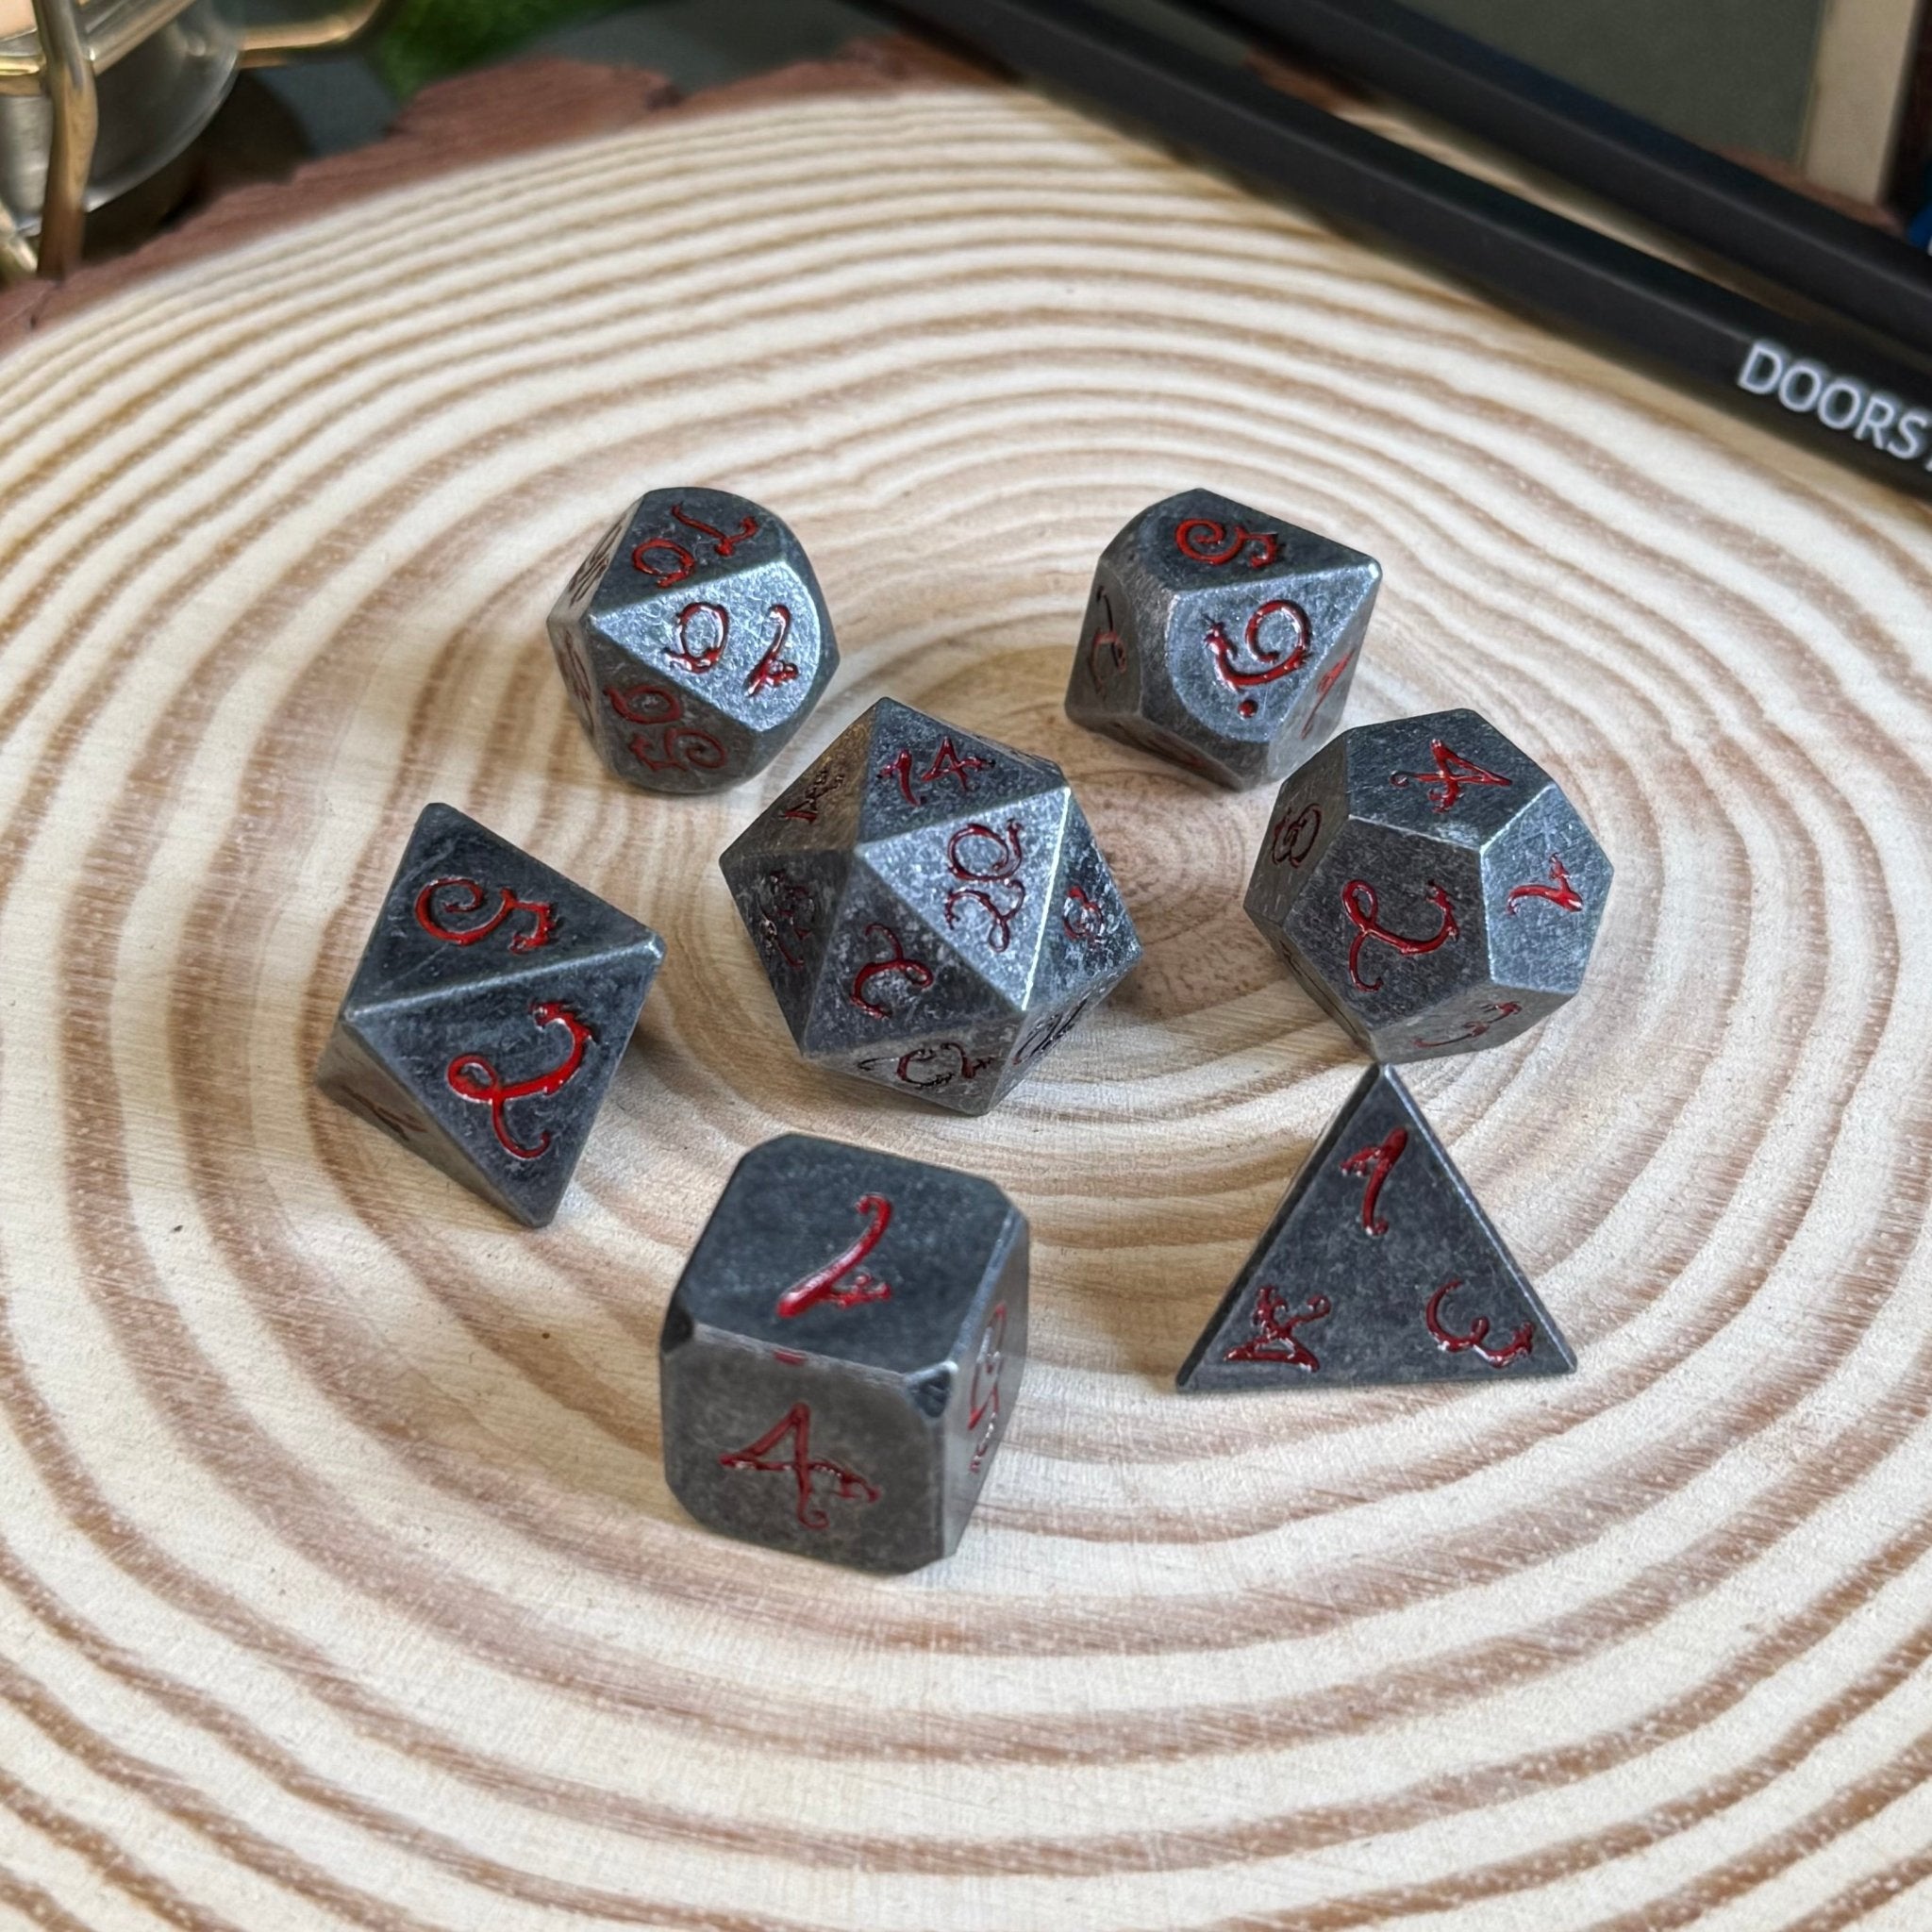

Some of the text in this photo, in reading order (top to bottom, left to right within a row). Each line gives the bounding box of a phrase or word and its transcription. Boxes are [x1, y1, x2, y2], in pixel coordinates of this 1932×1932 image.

[1738, 341, 1927, 459] DOORS
[875, 735, 996, 808] 14
[1389, 738, 1513, 815] 4
[414, 875, 559, 955] 5
[944, 817, 1025, 954] 20
[849, 922, 934, 1021] 2
[1341, 878, 1461, 993] 2
[445, 1000, 596, 1161] 2
[1224, 1284, 1331, 1373] 4
[1425, 1278, 1537, 1369] 3
[718, 1402, 881, 1531] 4
